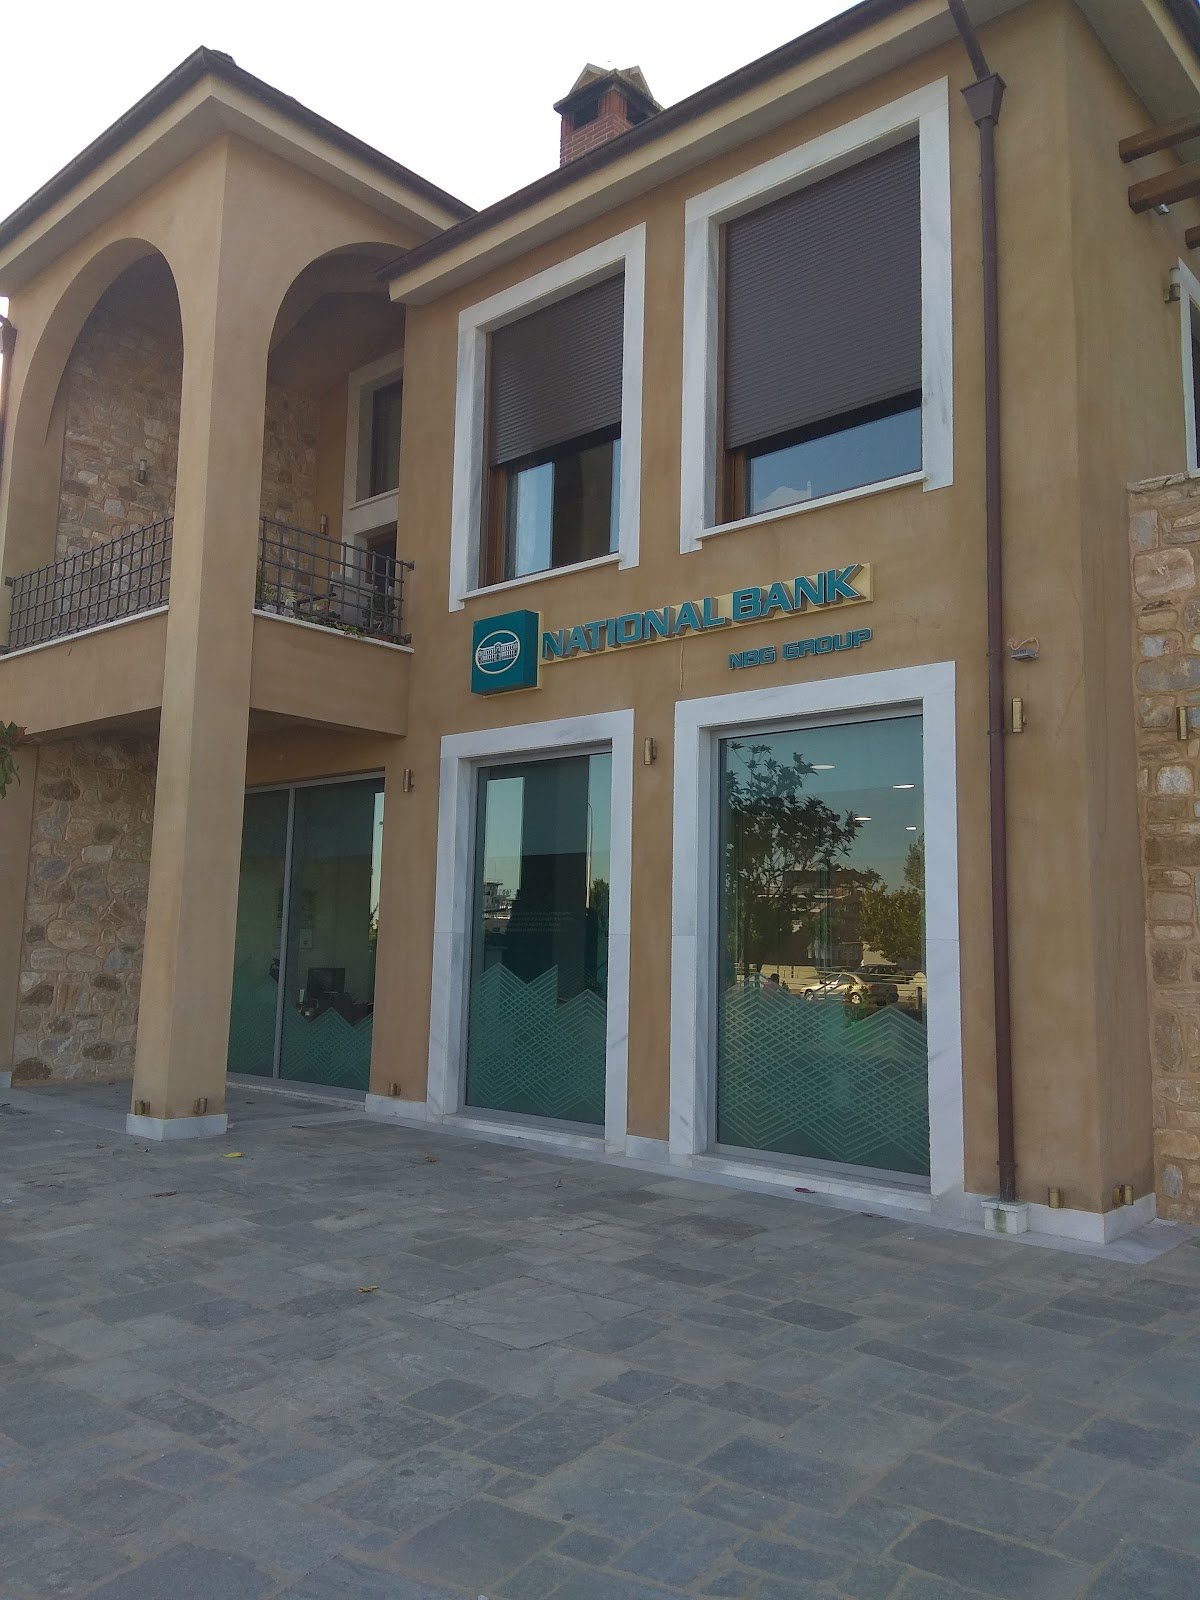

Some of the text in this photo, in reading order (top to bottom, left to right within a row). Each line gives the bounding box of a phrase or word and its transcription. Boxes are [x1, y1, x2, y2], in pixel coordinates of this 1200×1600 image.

[541, 563, 862, 660] NATIONAL BANK
[728, 628, 873, 670] NBG GROUP
